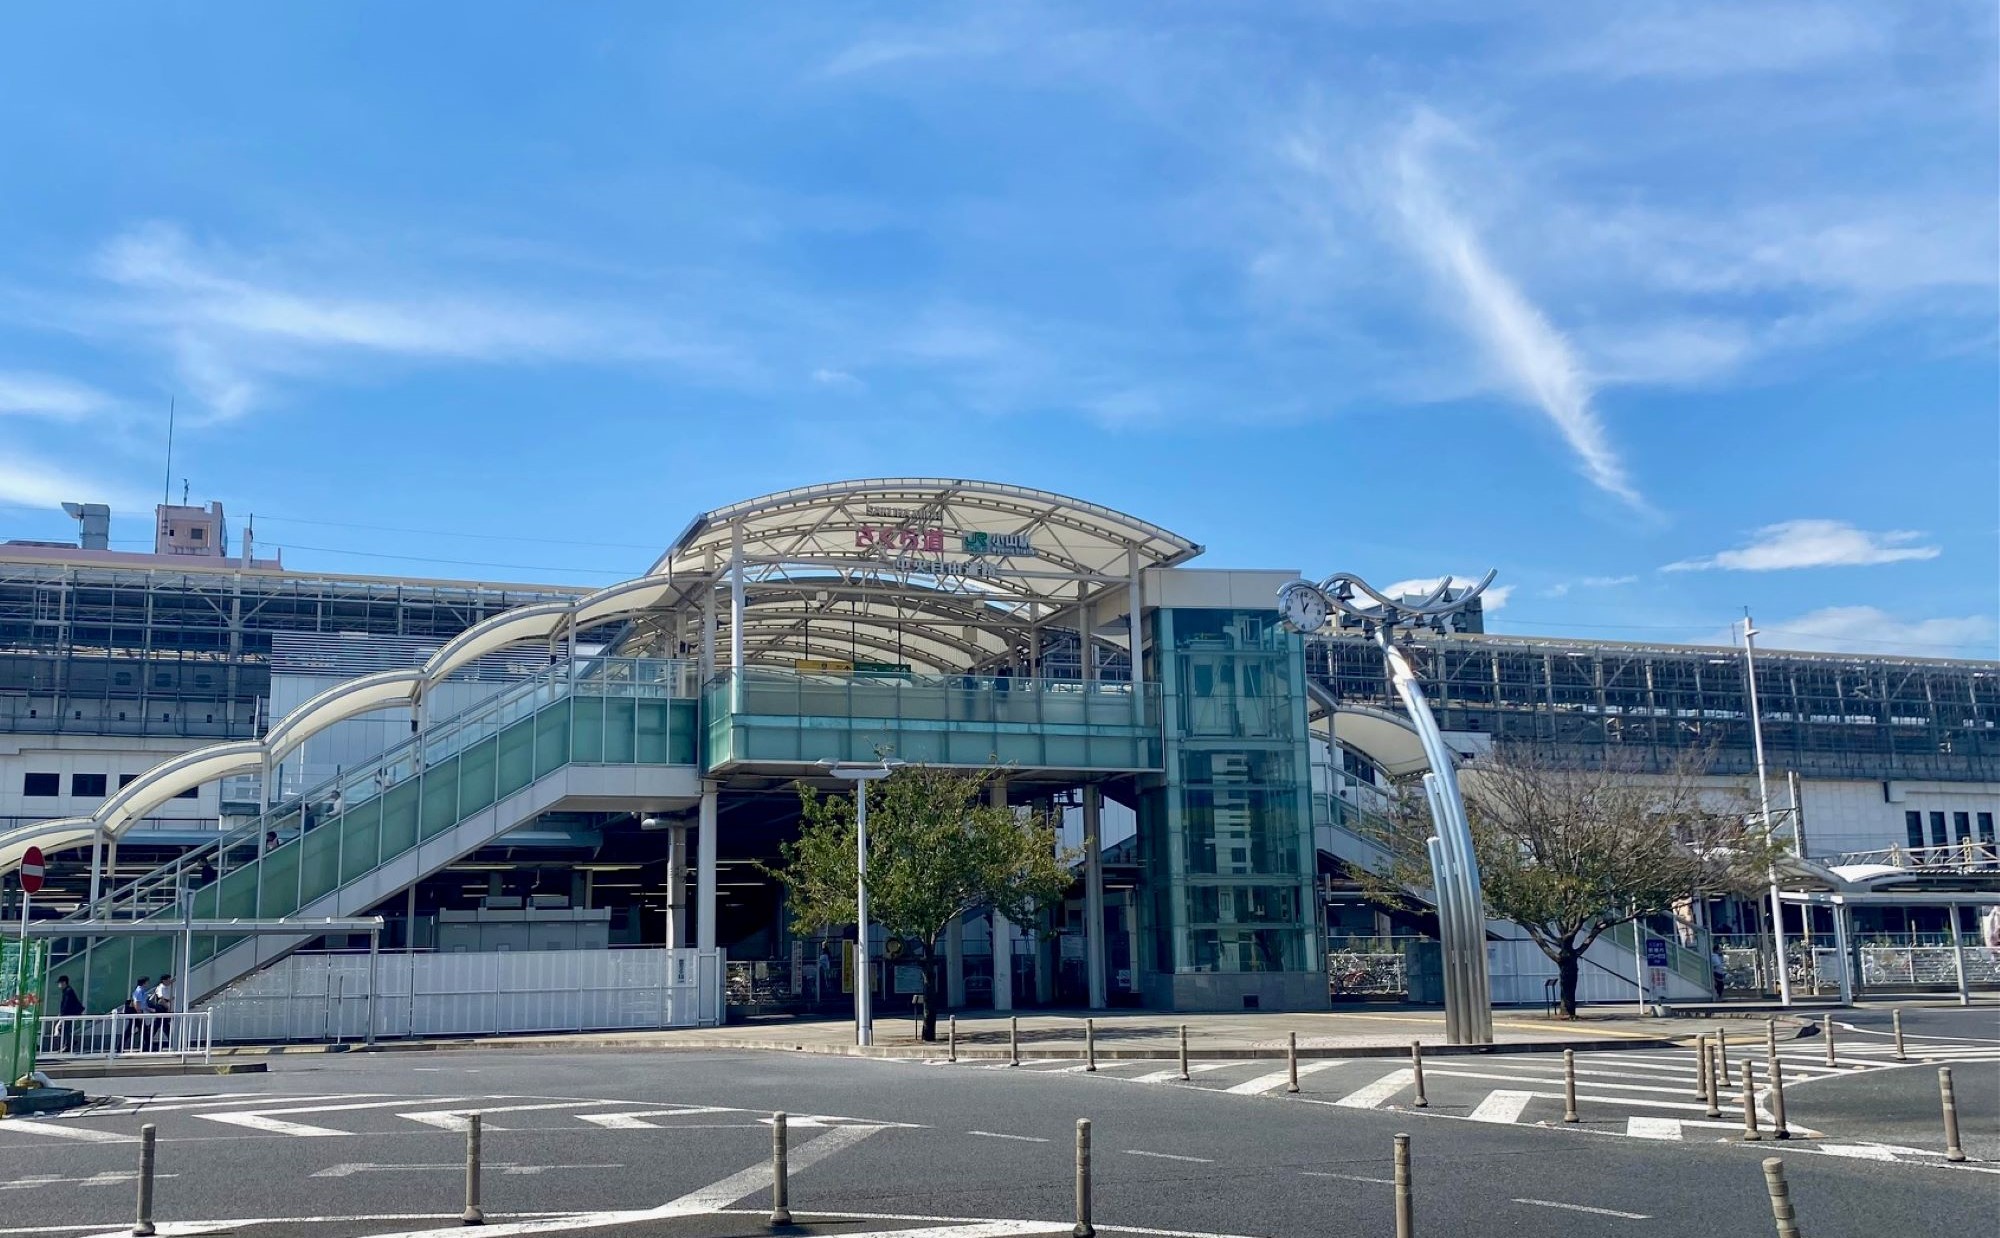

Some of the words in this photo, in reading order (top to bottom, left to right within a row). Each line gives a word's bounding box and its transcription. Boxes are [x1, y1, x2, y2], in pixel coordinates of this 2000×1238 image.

[855, 525, 944, 553] さくら道
[965, 531, 988, 547] JR
